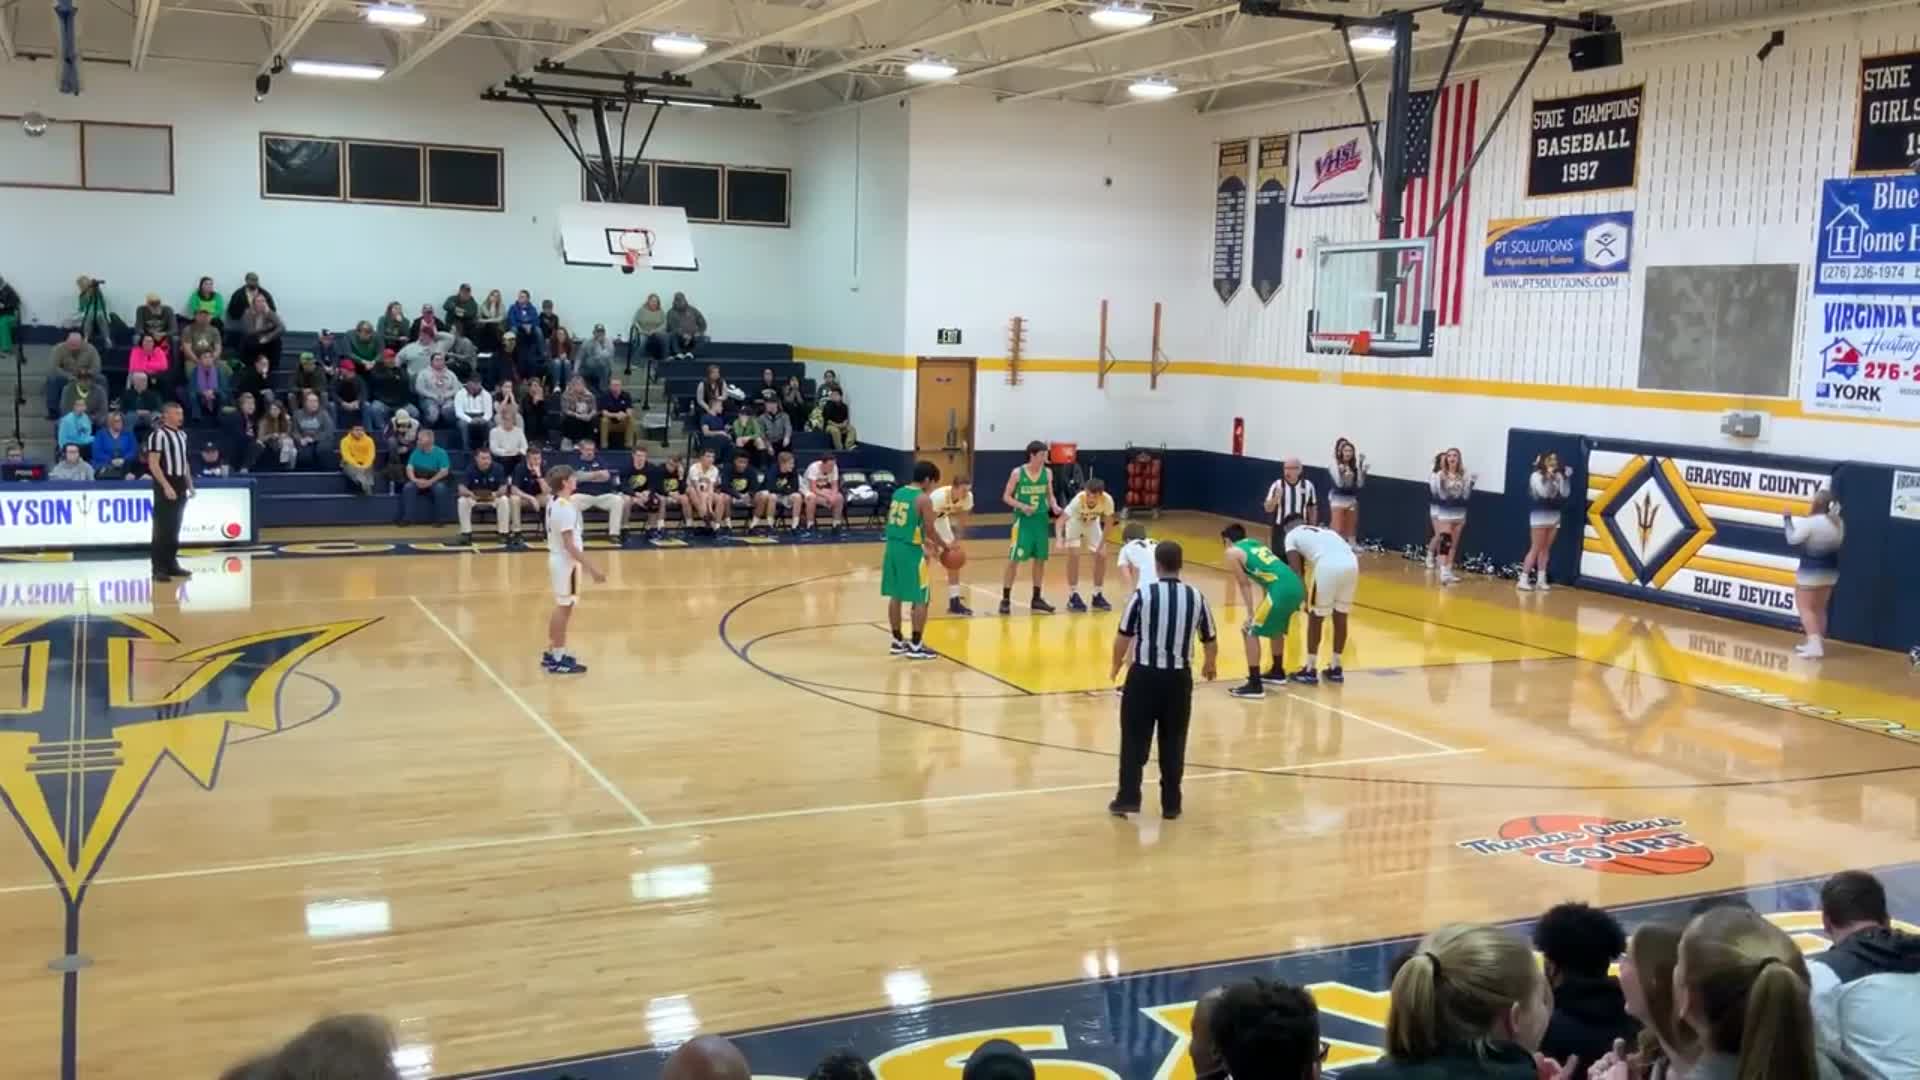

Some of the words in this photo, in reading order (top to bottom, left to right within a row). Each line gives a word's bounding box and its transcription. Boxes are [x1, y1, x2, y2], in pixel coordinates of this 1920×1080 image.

[1864, 64, 1912, 91] STATE
[1533, 108, 1565, 130] STATE
[1572, 97, 1639, 126] CHAMPIONS
[1537, 128, 1630, 157] BASEBALL
[1315, 138, 1361, 178] VHSL
[1562, 160, 1599, 183] 1997
[1872, 181, 1919, 210] Blue
[1495, 241, 1507, 254] PT
[1511, 238, 1574, 254] SOLUTIONS
[1491, 276, 1619, 290] WWW.PTSOLUTIONS.COM
[1824, 266, 1850, 280] (276)
[1853, 266, 1905, 279] 236-1974
[1824, 302, 1907, 334] VIRGINIA
[1832, 383, 1882, 402] YORK
[1685, 465, 1752, 489] GRAYSON
[1759, 473, 1823, 496] COUNTY
[889, 499, 910, 527] 25
[1693, 575, 1732, 599] BLUE
[1738, 583, 1794, 610] DEVILS
[1537, 831, 1697, 866] COURT
